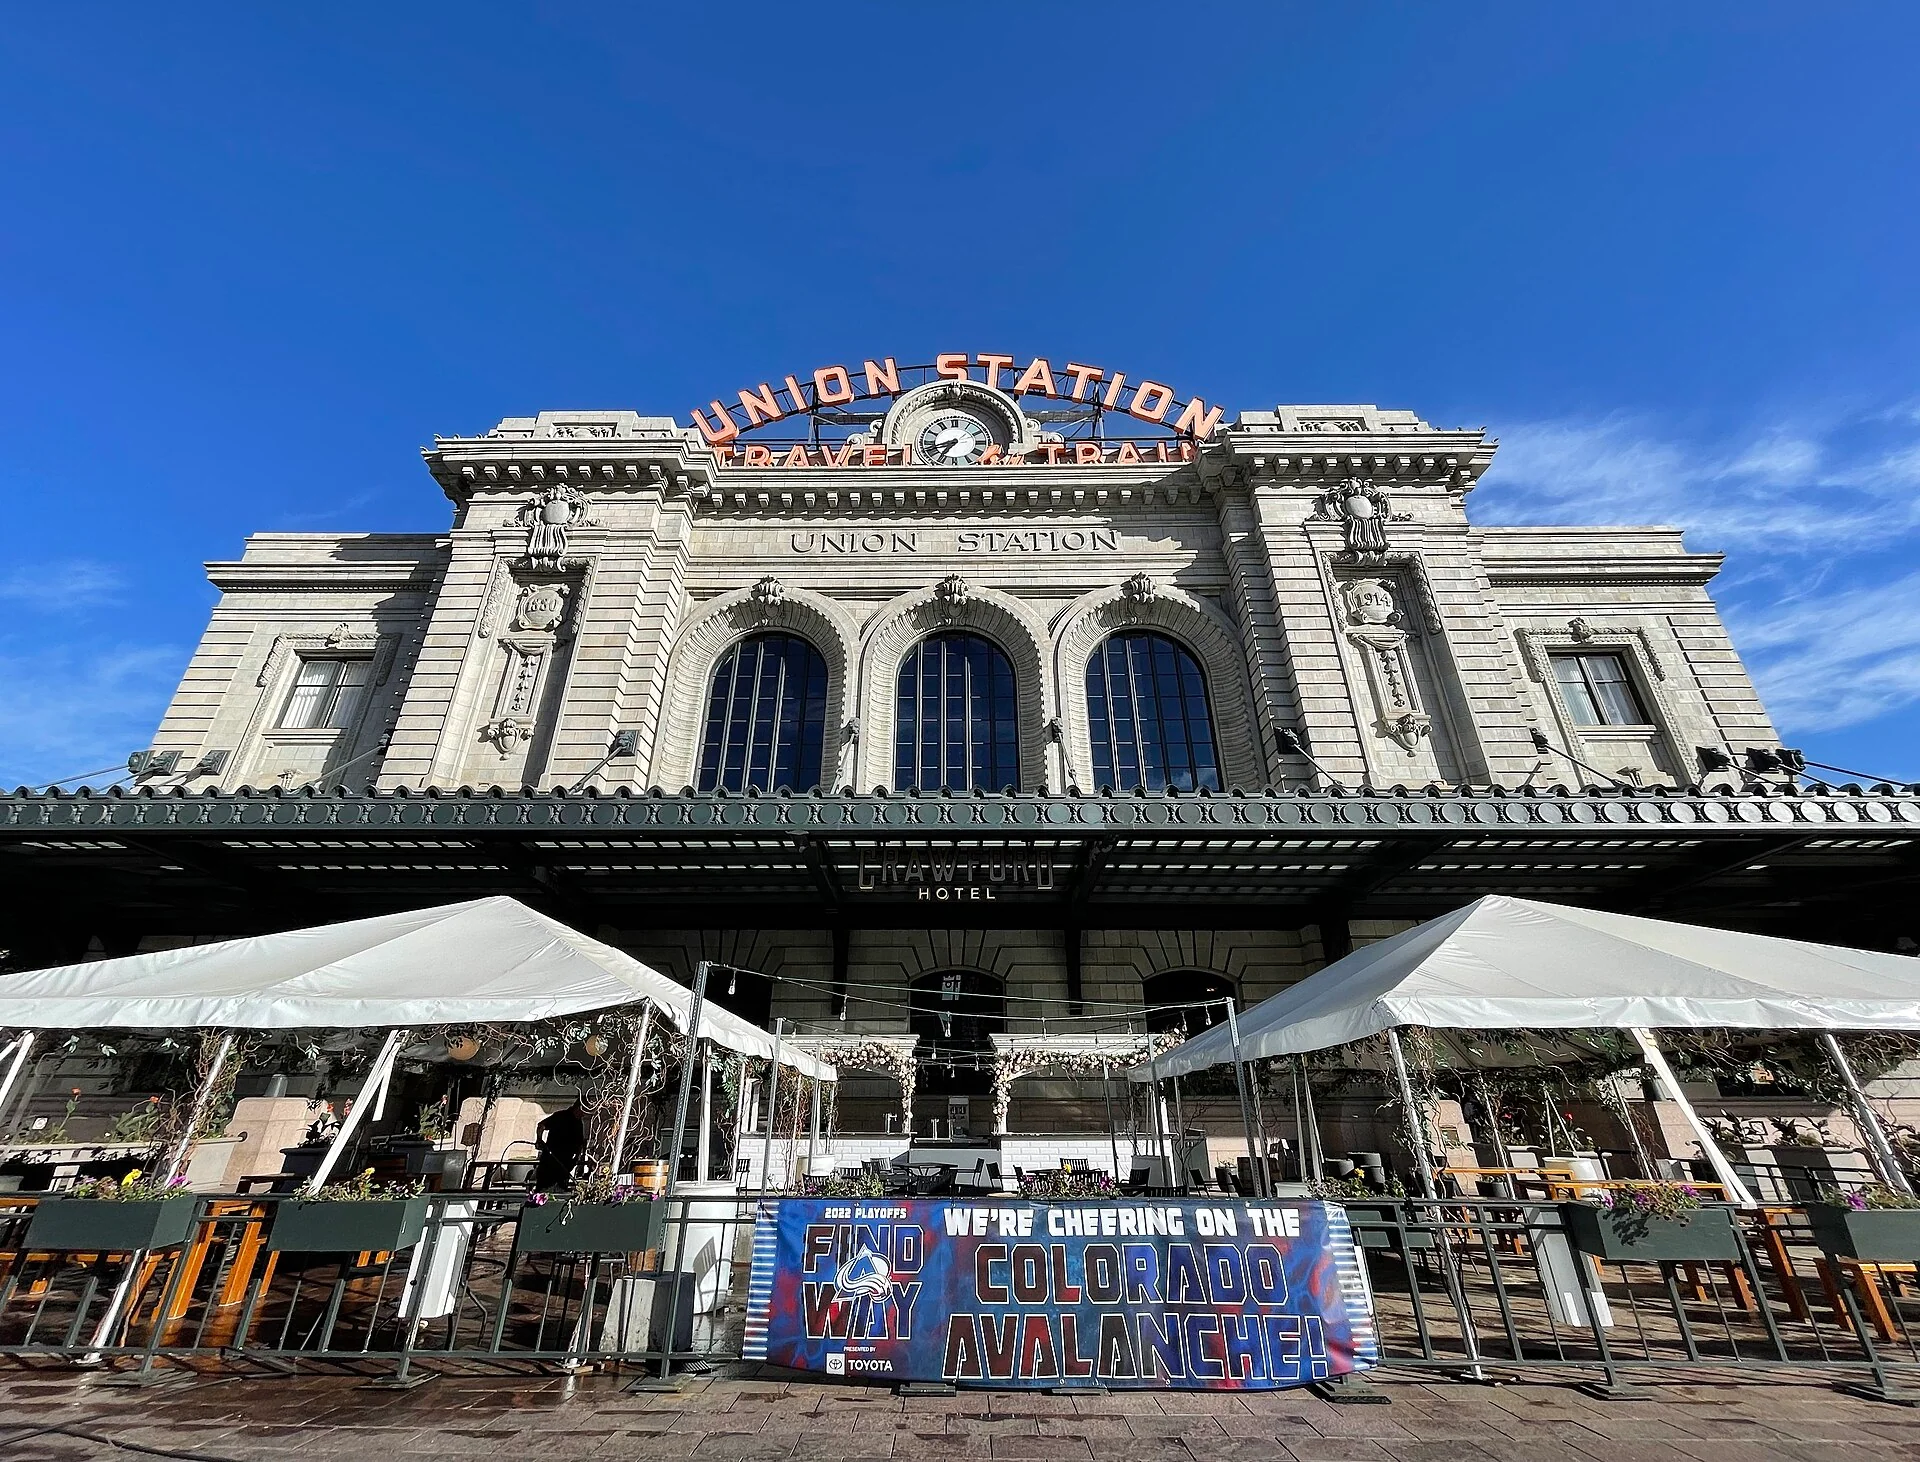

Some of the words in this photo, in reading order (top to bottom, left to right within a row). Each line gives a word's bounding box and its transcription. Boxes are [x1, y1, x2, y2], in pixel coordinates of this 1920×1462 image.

[690, 357, 900, 446] UNION
[935, 352, 1225, 442] STATION
[790, 531, 917, 554] UNION
[957, 529, 1118, 553] STATION
[1354, 592, 1391, 607] 1914
[858, 847, 1054, 890] CRAWFORD
[918, 887, 996, 900] HOTEL
[824, 1207, 851, 1219] 2022
[854, 1207, 907, 1219] PLAYOFFS
[943, 1207, 1035, 1237] WE'RE
[1047, 1207, 1186, 1237] CHEERING
[1196, 1208, 1240, 1237] ON
[1249, 1208, 1301, 1237] THE
[803, 1224, 925, 1275] FIND
[974, 1242, 1289, 1306] COLORADO
[802, 1281, 923, 1340] WAY
[941, 1312, 1330, 1380] AVALANCHE!
[848, 1359, 893, 1372] TOYOTA
